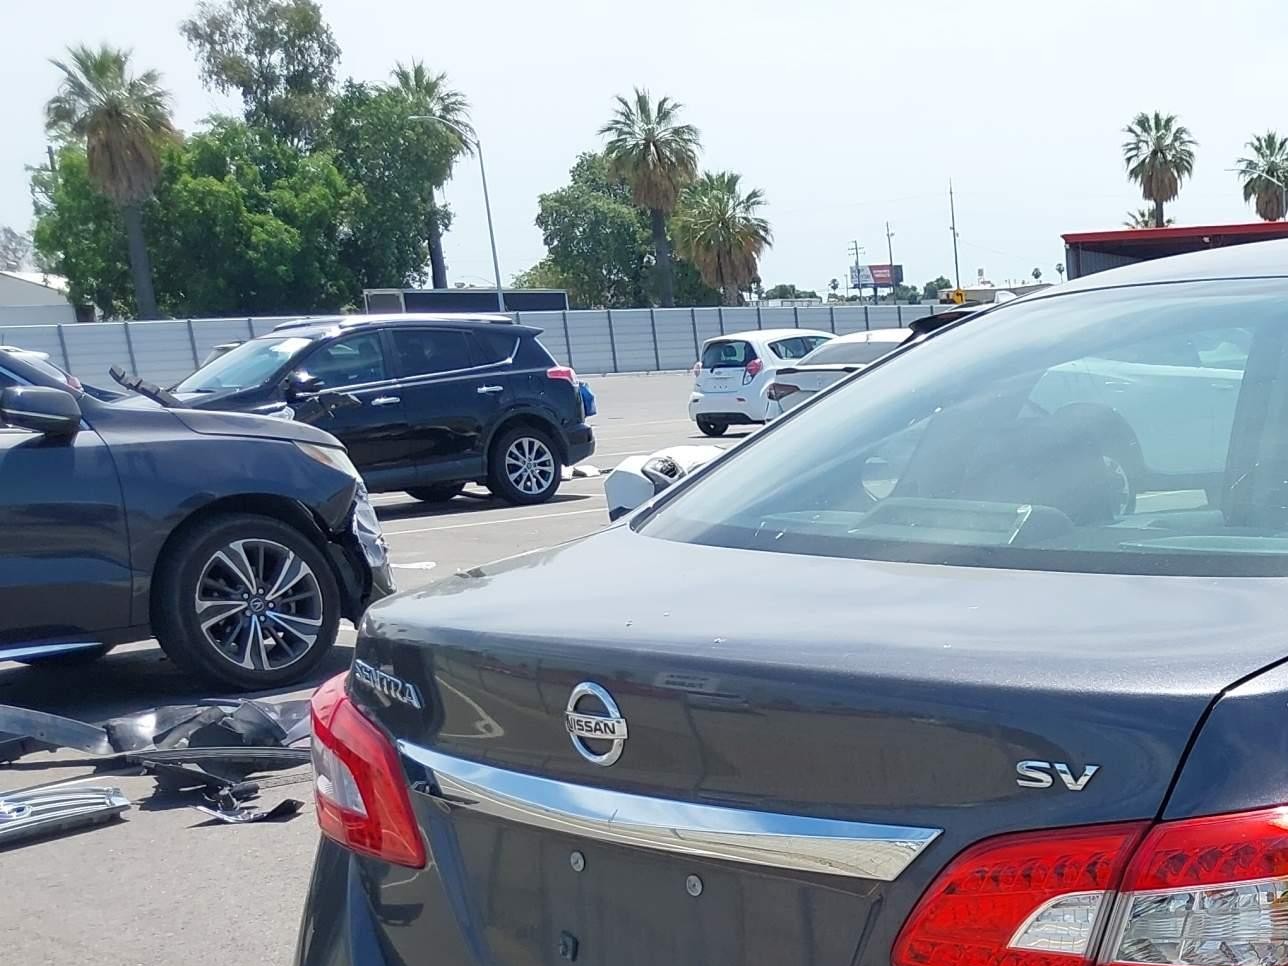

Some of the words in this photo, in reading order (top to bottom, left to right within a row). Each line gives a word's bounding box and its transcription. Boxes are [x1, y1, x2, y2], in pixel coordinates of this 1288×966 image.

[355, 658, 422, 709] SENTRA
[566, 716, 617, 735] NISSAN
[1016, 760, 1100, 791] SV
